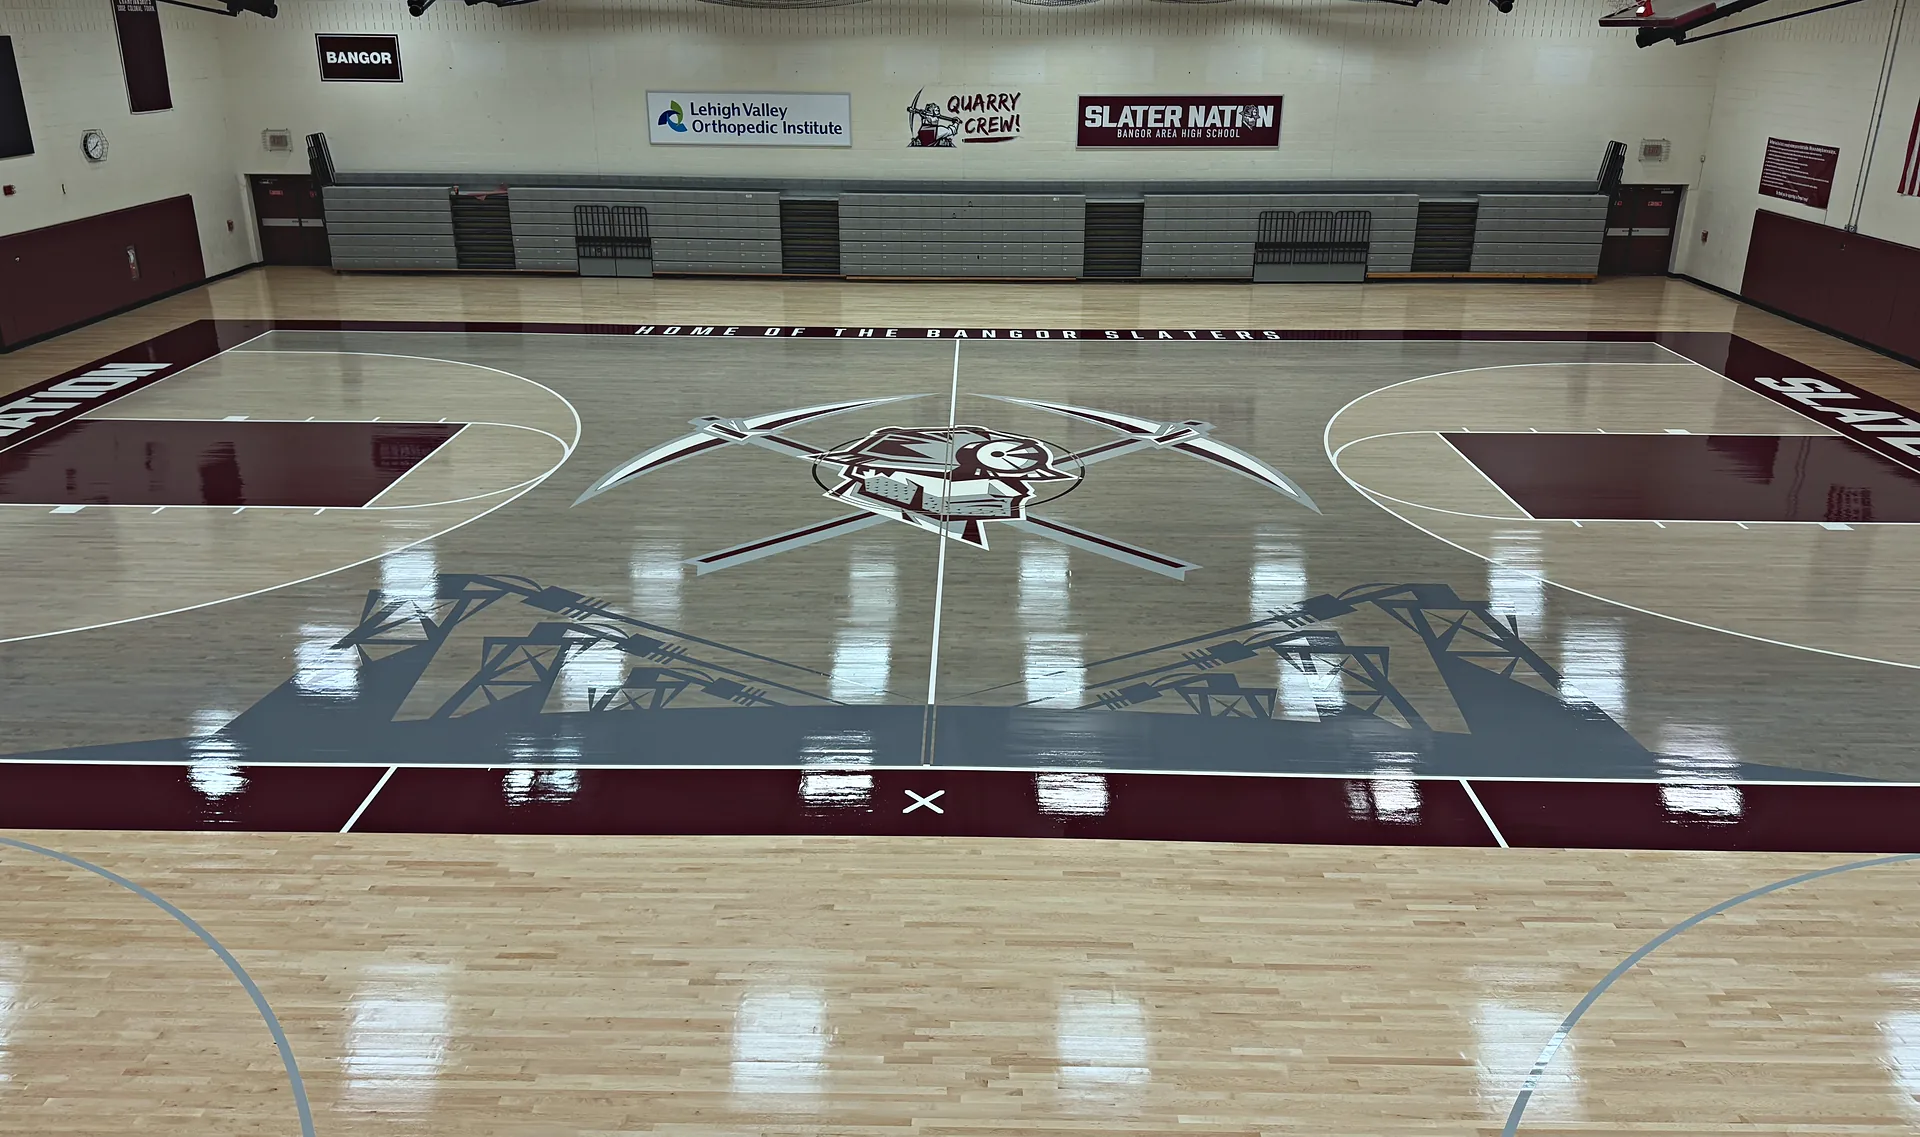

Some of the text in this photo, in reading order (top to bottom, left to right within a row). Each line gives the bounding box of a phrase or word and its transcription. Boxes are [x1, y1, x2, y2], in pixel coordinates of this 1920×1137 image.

[326, 51, 393, 65] BANGOR
[690, 102, 788, 121] Lehigh Valley
[947, 91, 1021, 115] QUARRY
[964, 113, 1021, 136] CREW!
[1084, 105, 1275, 128] SLATER NATIN
[692, 119, 843, 137] Orthopedic Institute
[1117, 128, 1241, 138] BANGOR AREA HIGH SCHOOL
[634, 325, 1282, 340] HOME OF THE BANGOR SLATERS
[0, 362, 174, 438] ATION
